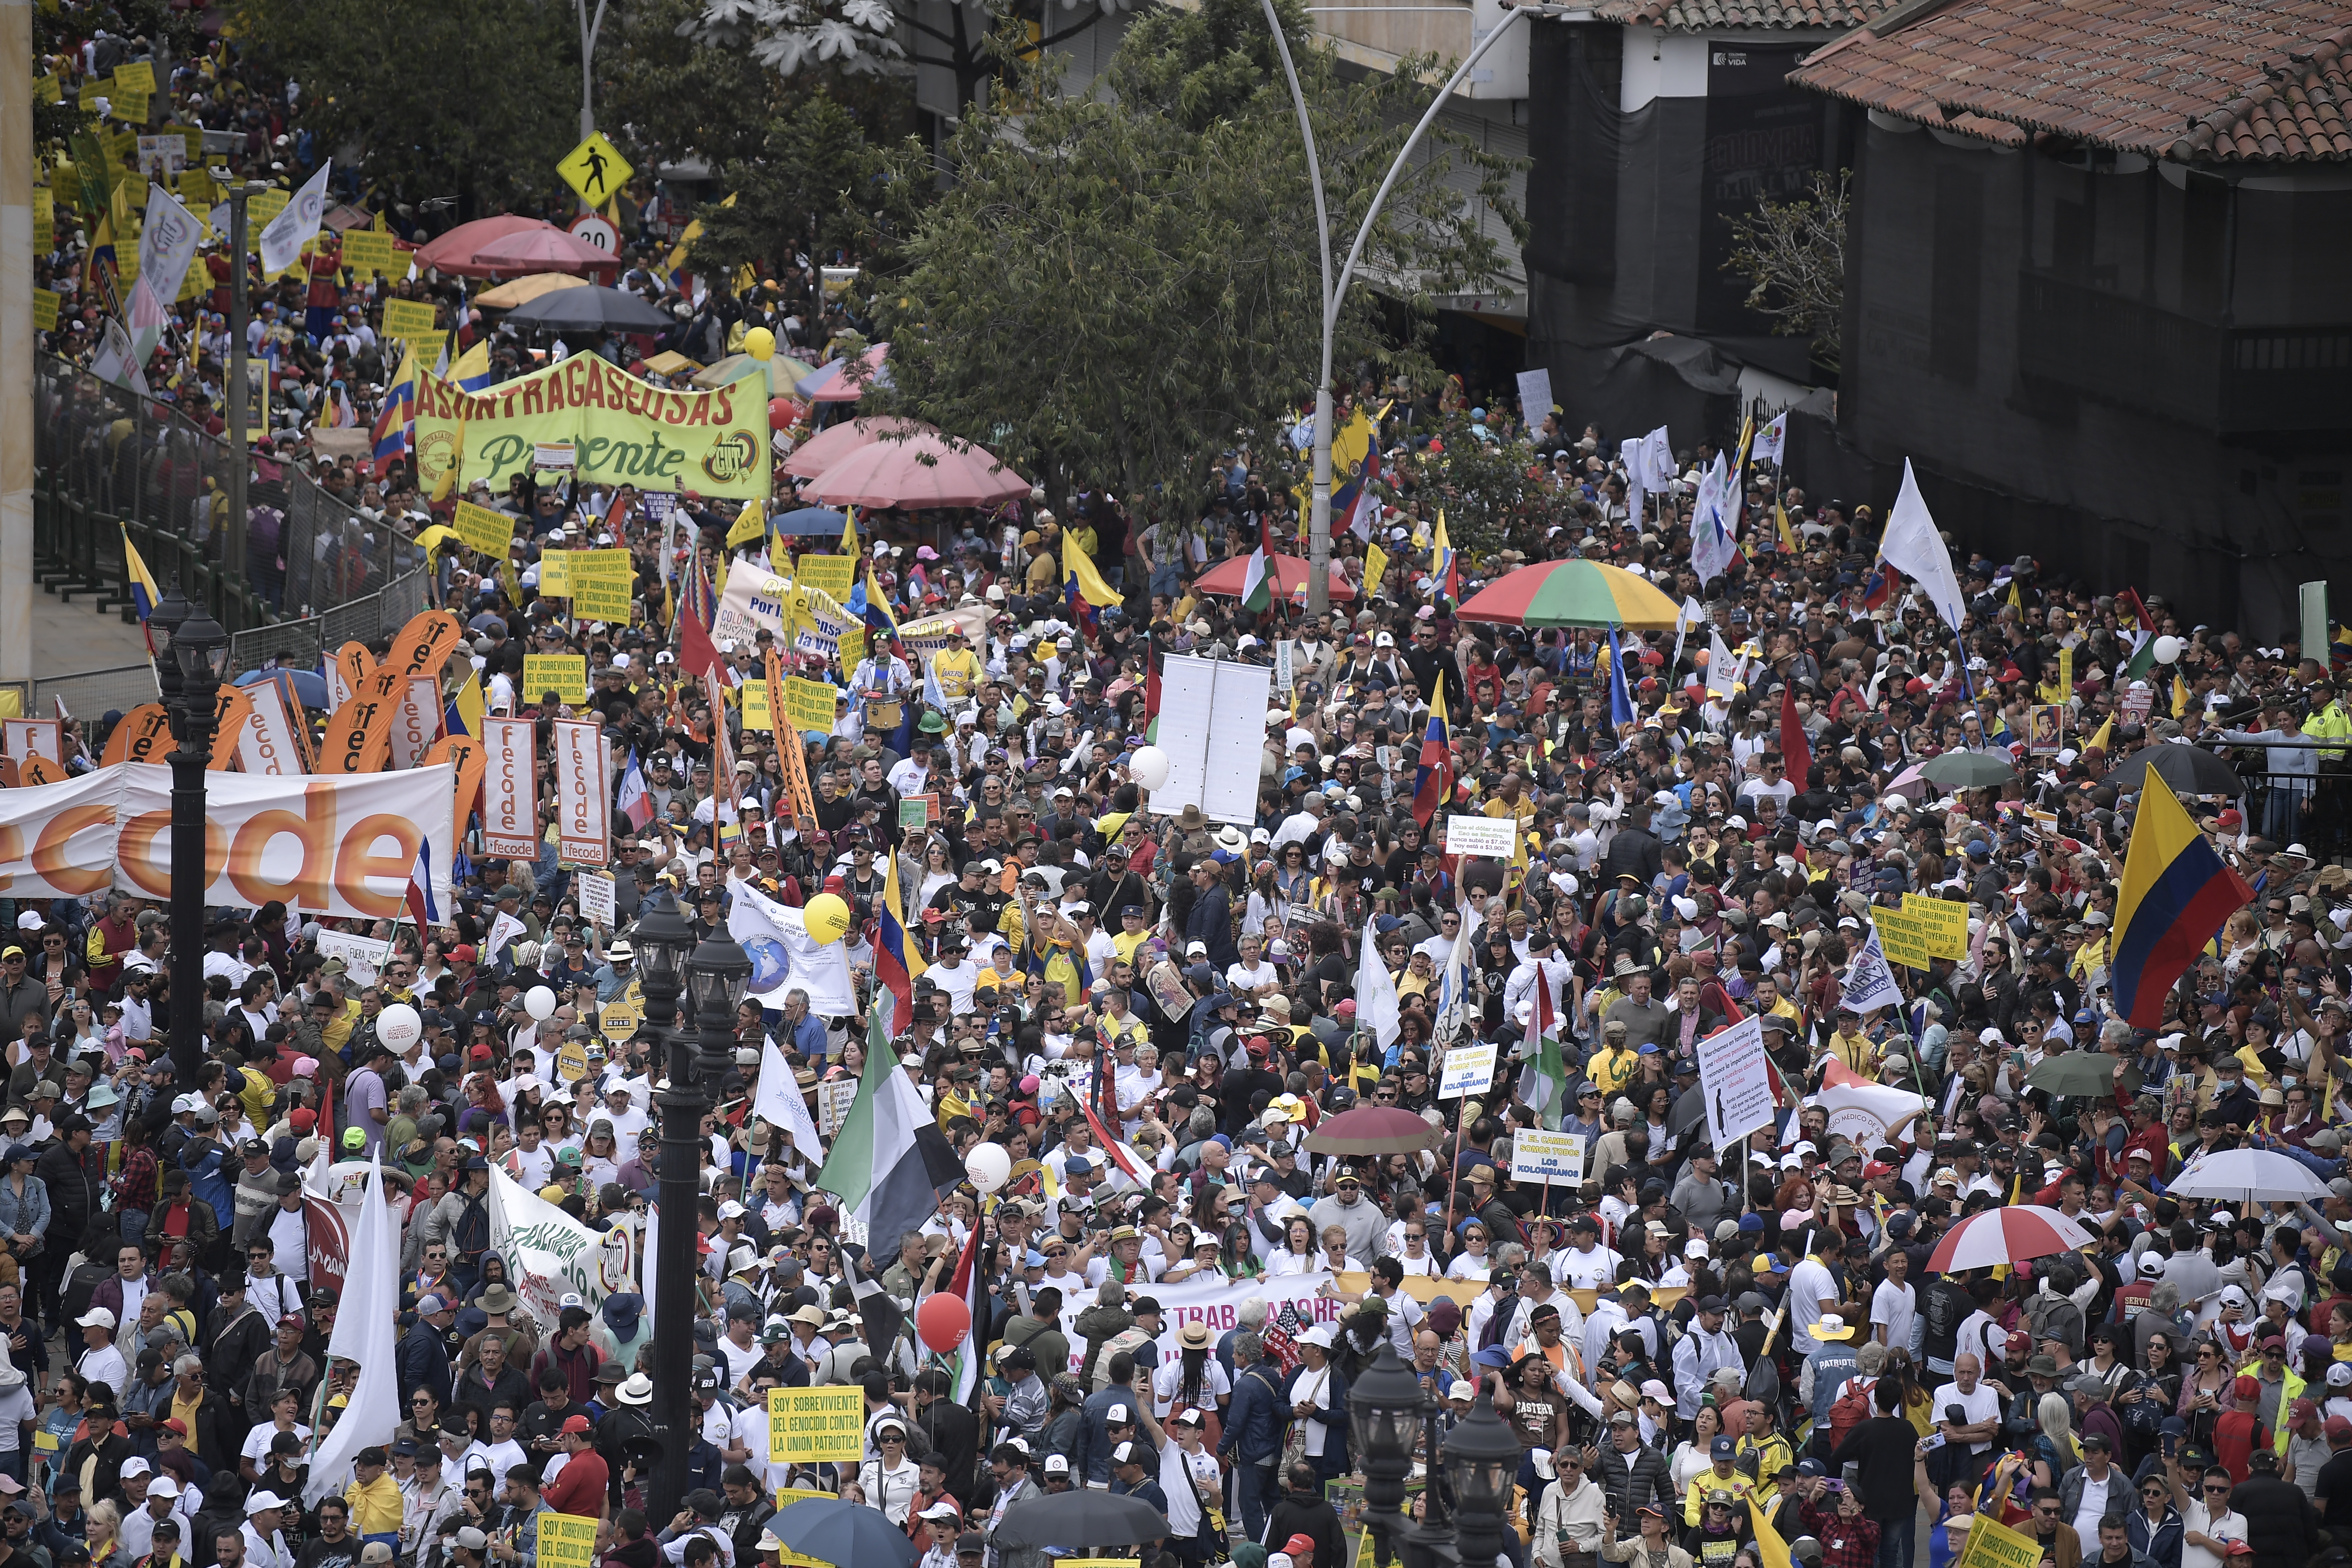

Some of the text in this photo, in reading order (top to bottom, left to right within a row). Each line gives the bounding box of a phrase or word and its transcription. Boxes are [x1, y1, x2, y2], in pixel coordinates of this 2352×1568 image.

[1712, 124, 1816, 171] COLOMBIA
[415, 358, 737, 426] ASONTRAGASEOSAS
[479, 430, 684, 479] Prente
[715, 443, 743, 472] CUT
[461, 504, 511, 528] SOY SOBREVIVIENTE
[458, 513, 509, 538] DEL GENOCIDIO CONTRA
[571, 552, 626, 563] SOY SOBREVIVIENTE
[801, 558, 850, 569] SOY SOBREVIVIENTE
[808, 569, 832, 578] GENOCIDIO
[832, 570, 849, 578] CONTRA
[577, 580, 629, 593] SOY SOBREVIVIENTE
[575, 591, 629, 604] DEL GENOCIDIO CONTRA
[576, 602, 629, 617] LA UNIÓN PATRIÓTICA
[841, 636, 850, 646] SOY
[842, 647, 850, 657] DEL
[527, 660, 581, 671] SOY SOBREVIVIENTE
[526, 673, 582, 683] DEL GENOCIDIO CONTRA
[941, 668, 964, 677] LAKERS
[789, 680, 835, 700] SOY SOBREVIVIENTE
[789, 693, 833, 713] DEL GENOCIDIO CONTRA
[2122, 700, 2132, 709] NO
[501, 725, 516, 830] fecode
[571, 727, 589, 833] fecode
[0, 781, 425, 918] code
[493, 840, 532, 855] fecode
[569, 844, 601, 859] fecode
[1855, 861, 1860, 869] NO
[589, 877, 599, 885] Gobierno
[1361, 877, 1374, 891] NY
[597, 896, 608, 904] potable
[1907, 896, 1962, 914] POR LAS REFORMAS
[1292, 908, 1306, 916] GUERRA,
[1908, 907, 1958, 924] DEL GOBIERNO DEL
[1875, 913, 1923, 934] SOY SOBREVIVIENTE
[785, 928, 796, 936] POR
[1876, 926, 1925, 949] DEL GENOCIDIO CONTRA
[1949, 935, 1957, 944] YA
[358, 961, 373, 974] MAFIA
[387, 1028, 414, 1036] LUCHAMOS
[1704, 1043, 1729, 1059] Marchamos
[1734, 1031, 1749, 1043] familia
[1713, 1052, 1731, 1064] reforma
[1731, 1042, 1750, 1057] pensional
[1750, 1037, 1760, 1045] que
[1464, 1050, 1488, 1060] CAMBIO
[568, 1060, 583, 1068] BAJADO
[1448, 1059, 1492, 1072] SOMOS TODOS
[1707, 1065, 1725, 1080] reconoce
[1730, 1049, 1753, 1067] importancia
[1461, 1072, 1473, 1080] LOS
[1444, 1078, 1489, 1091] KOLOMBIANOS
[1728, 1077, 1745, 1089] abuelas
[1739, 1109, 1760, 1124] pensionarse
[1841, 1113, 1877, 1128] MÉDICO DE
[1528, 1135, 1573, 1146] EL CAMBIO
[1519, 1144, 1579, 1157] SOMOS TODOS
[1541, 1158, 1558, 1166] LOS
[1517, 1165, 1579, 1178] KOLOMBIANOS
[1819, 1358, 1857, 1370] PATRIOTS
[701, 1379, 715, 1388] 69
[773, 1395, 858, 1412] SOY SOBREVIVIENTE
[1516, 1402, 1554, 1416] EASTERN
[773, 1415, 859, 1432] DEL GENOCIDIO CONTRA
[773, 1432, 859, 1452] LA UNIÓN PATRIÓTICA
[544, 1520, 559, 1536] SOY
[542, 1540, 579, 1560] DEL GENOCIDIO
[1981, 1532, 2035, 1568] SOBREVIVIENTE
